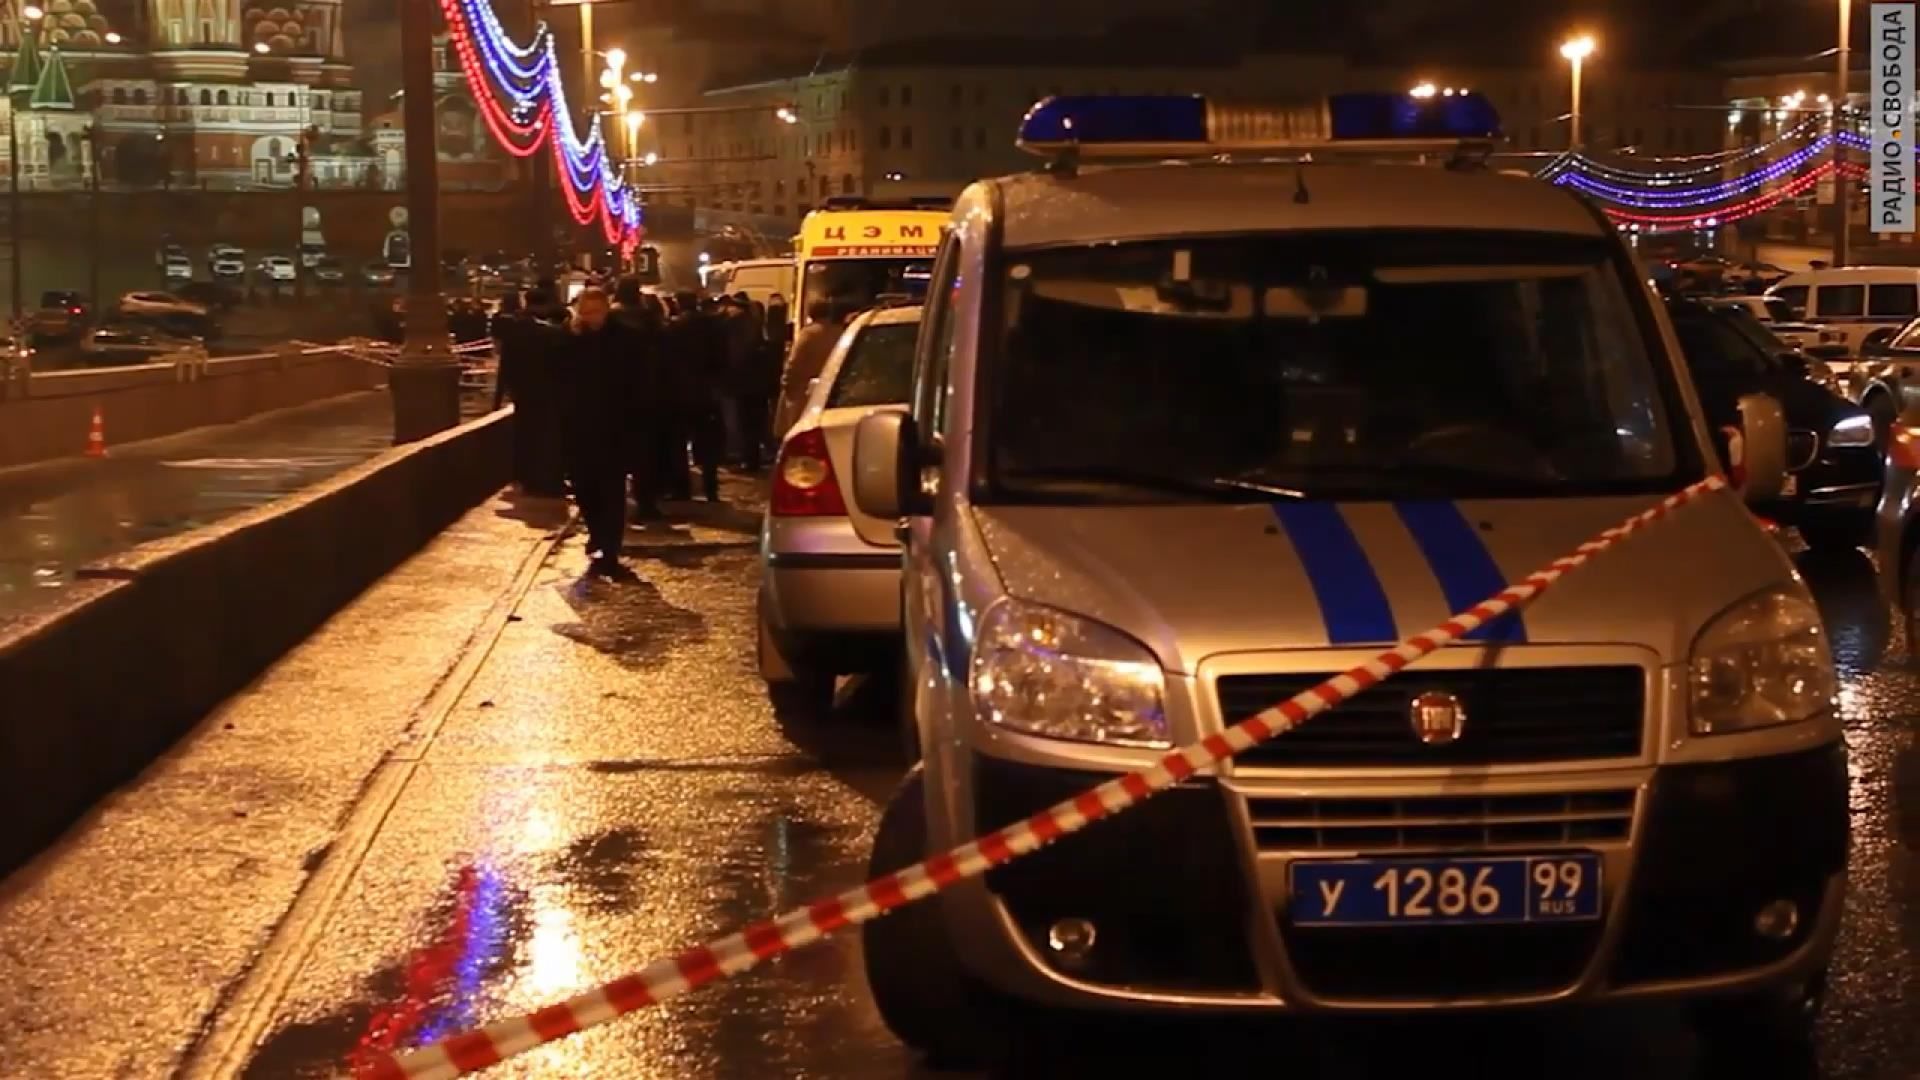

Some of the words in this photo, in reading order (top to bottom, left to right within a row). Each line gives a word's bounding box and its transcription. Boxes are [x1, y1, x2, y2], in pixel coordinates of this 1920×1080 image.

[824, 225, 945, 240] ЦЭМ
[1373, 867, 1500, 917] 1286
[1533, 861, 1583, 898] 99
[1539, 900, 1577, 914] RUS
